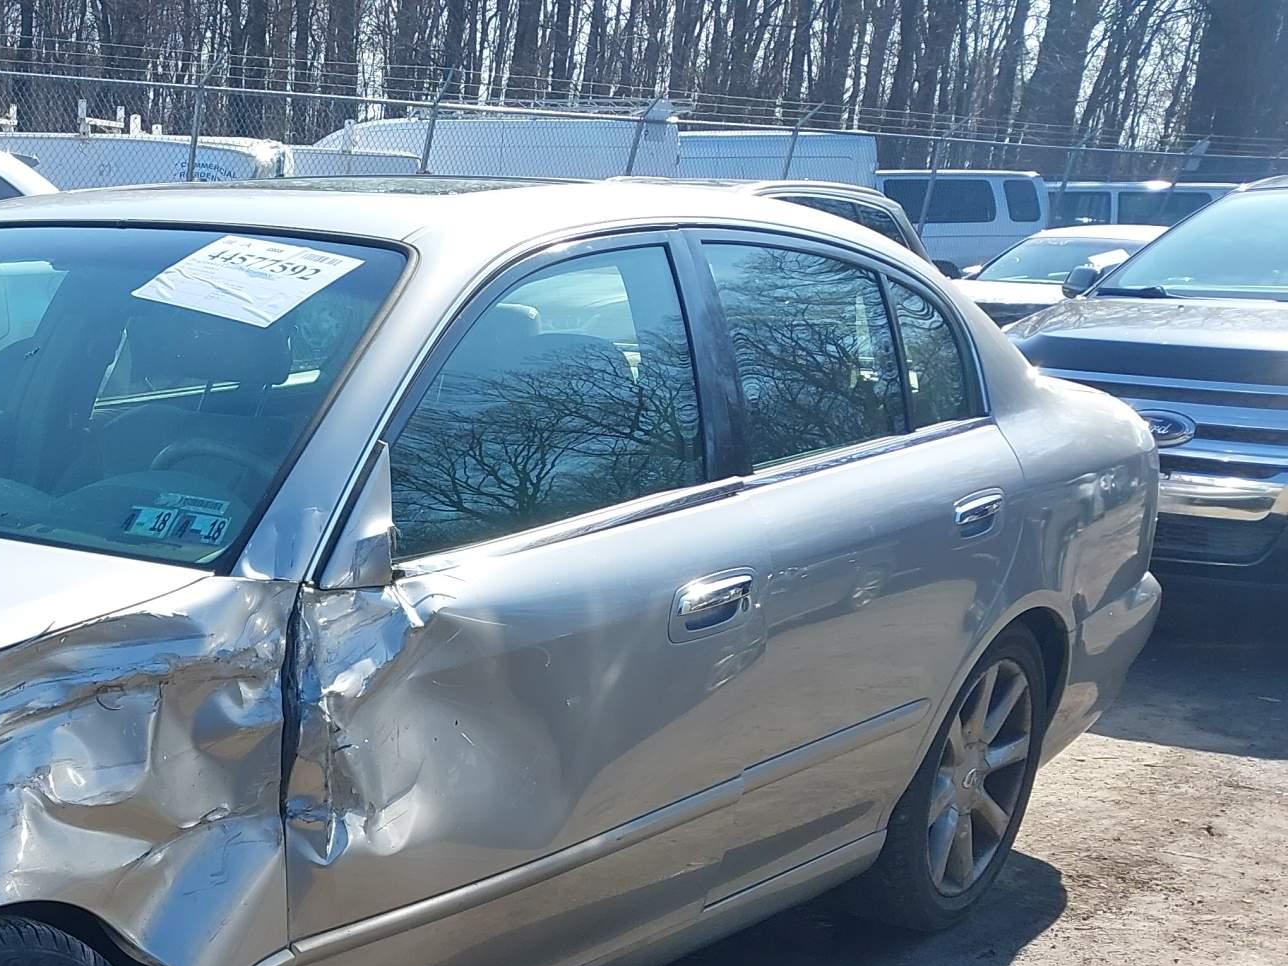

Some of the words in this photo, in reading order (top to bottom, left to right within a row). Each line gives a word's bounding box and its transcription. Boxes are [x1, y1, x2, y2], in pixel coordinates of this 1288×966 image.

[180, 161, 237, 179] CMMERCIAL
[208, 249, 321, 281] 44577592
[149, 511, 172, 532] 18
[204, 519, 226, 541] 18
